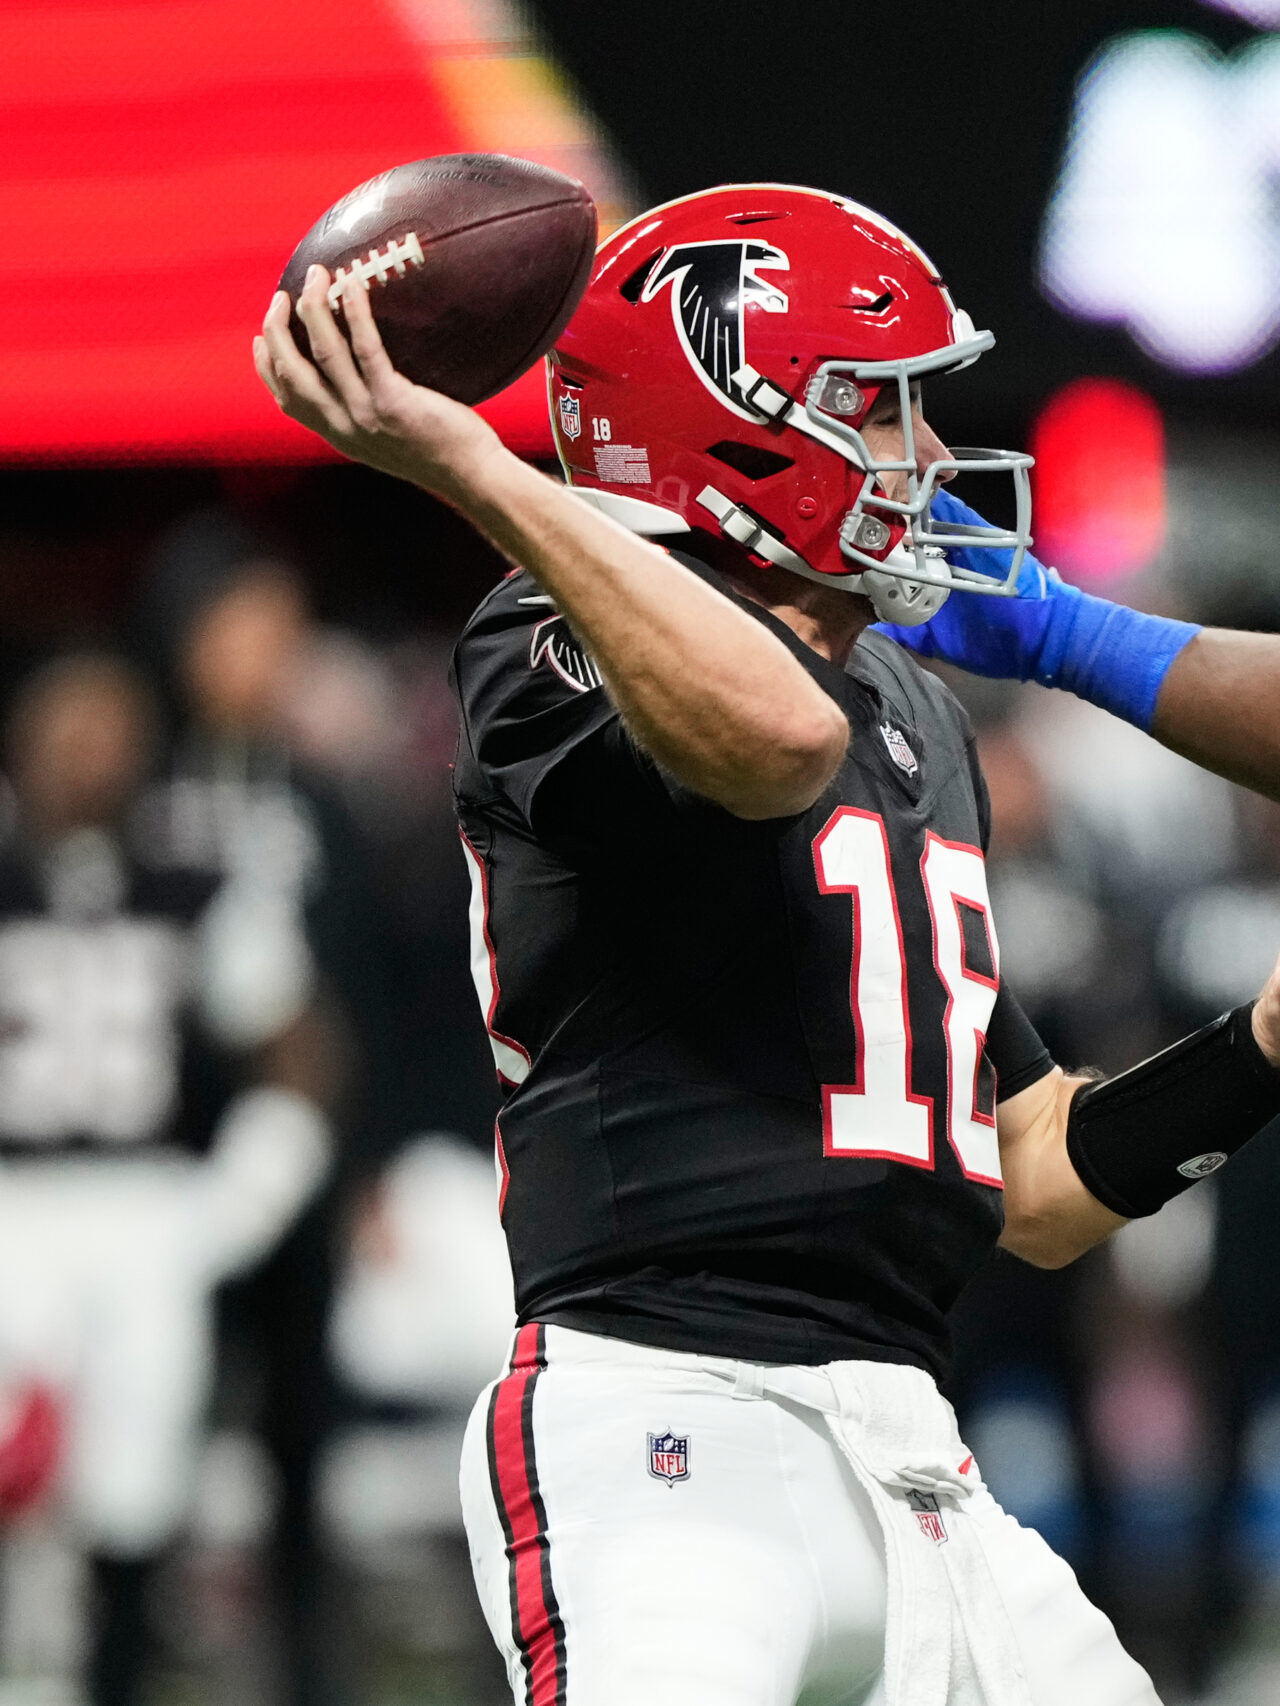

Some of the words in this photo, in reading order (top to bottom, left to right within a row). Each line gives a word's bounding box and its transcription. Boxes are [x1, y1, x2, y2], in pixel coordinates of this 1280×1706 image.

[563, 413, 578, 433] NFL
[592, 417, 611, 441] 18
[811, 804, 1004, 1190] 18
[655, 1453, 684, 1475] NFL
